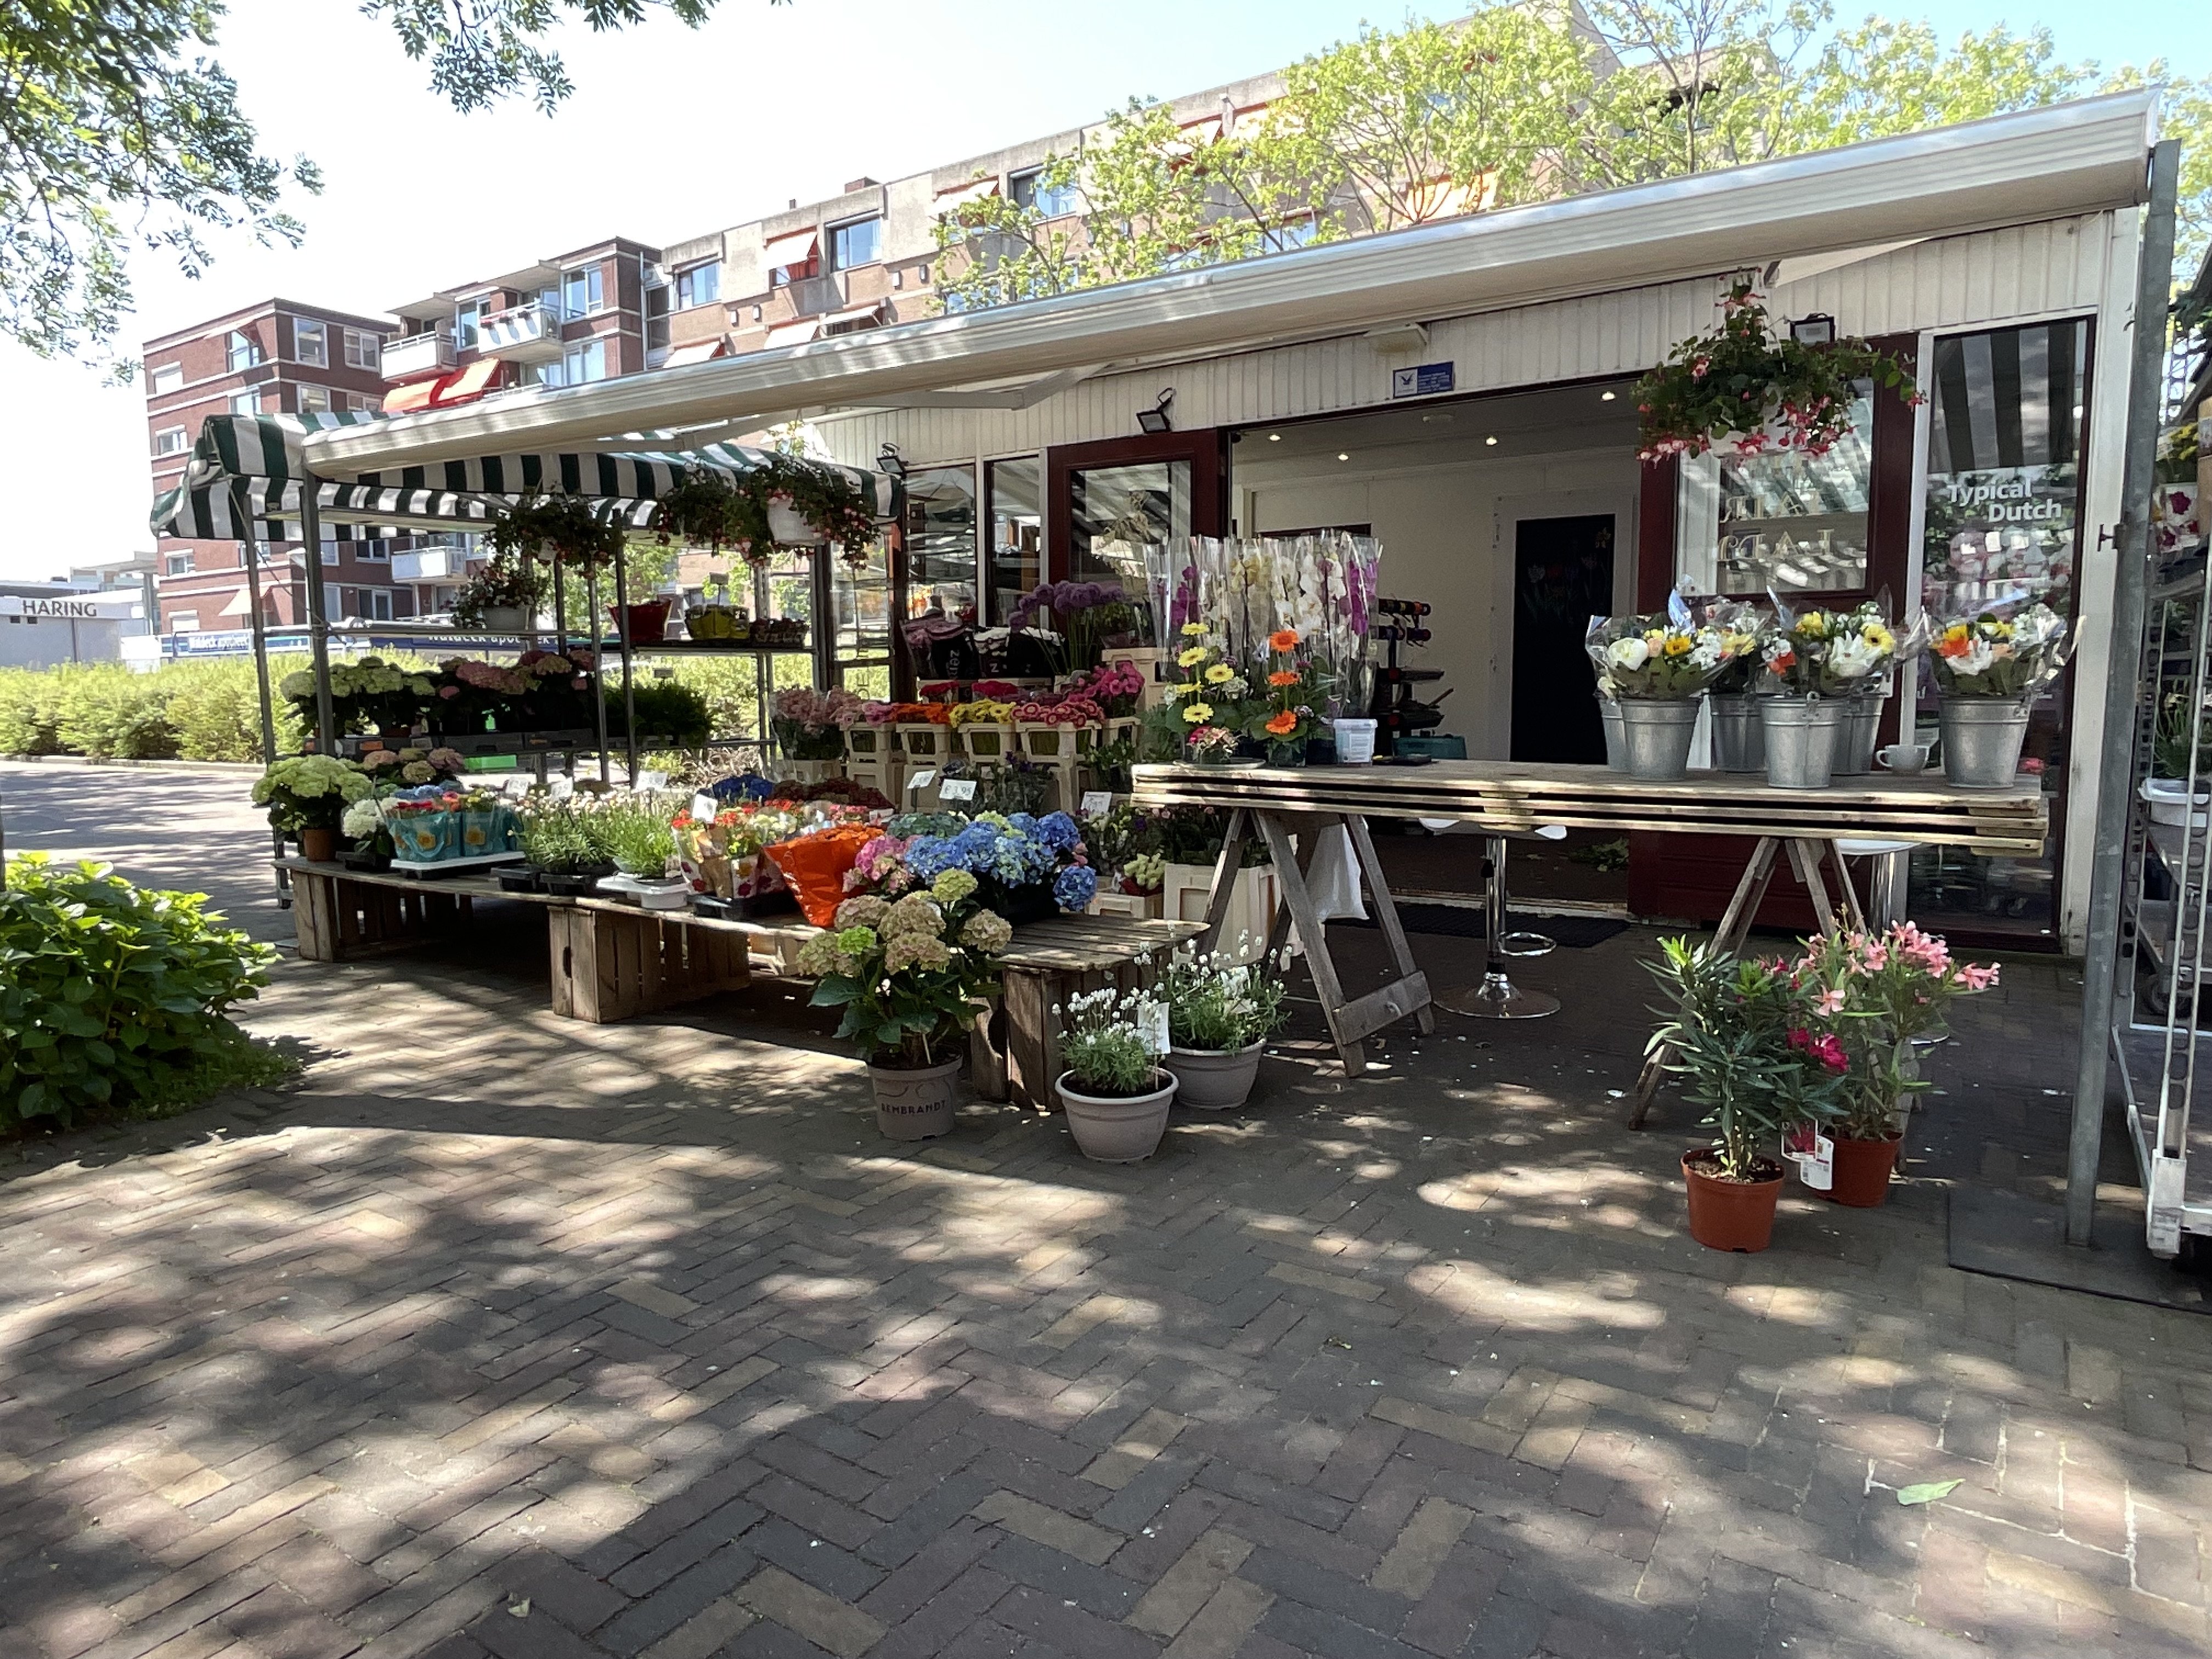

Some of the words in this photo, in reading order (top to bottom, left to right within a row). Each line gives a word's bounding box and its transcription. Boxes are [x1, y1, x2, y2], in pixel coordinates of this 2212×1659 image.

[1947, 477, 2032, 507] Typical
[1988, 498, 2062, 522] Dutch
[22, 600, 97, 617] HARING
[881, 1100, 946, 1114] REMBRANDT
